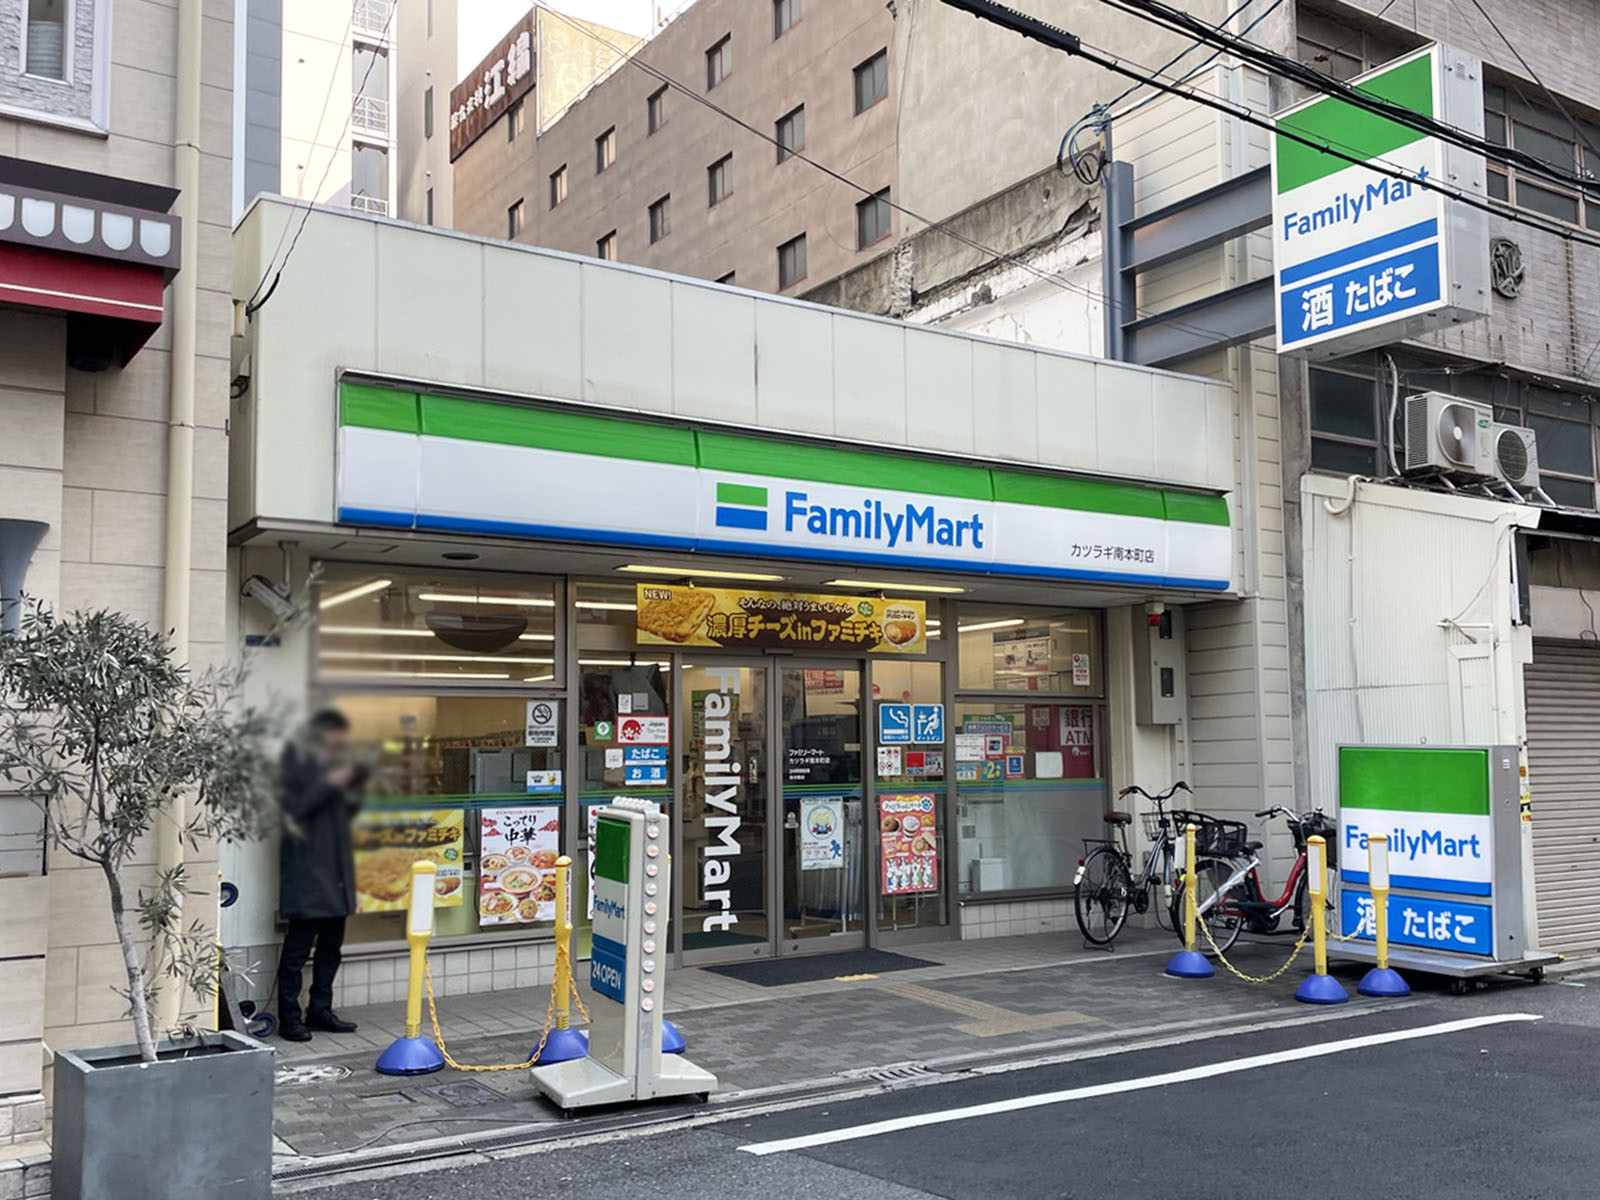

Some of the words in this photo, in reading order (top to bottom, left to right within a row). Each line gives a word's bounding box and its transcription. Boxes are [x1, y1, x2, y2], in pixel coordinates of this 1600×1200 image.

[1301, 284, 1334, 332] 酒
[1345, 263, 1417, 315] たばこ
[785, 491, 984, 550] FamilyMart
[1071, 543, 1155, 563] カツラギ南本町店
[644, 588, 672, 600] NEW!
[707, 612, 883, 643] 濃厚チーズinファミチキ
[631, 748, 660, 760] たばこ
[703, 667, 741, 932] FamilyMart
[503, 815, 537, 827] こってり
[504, 827, 537, 846] 中華
[594, 894, 625, 920] FamilyMart
[1403, 907, 1476, 943] たばこ
